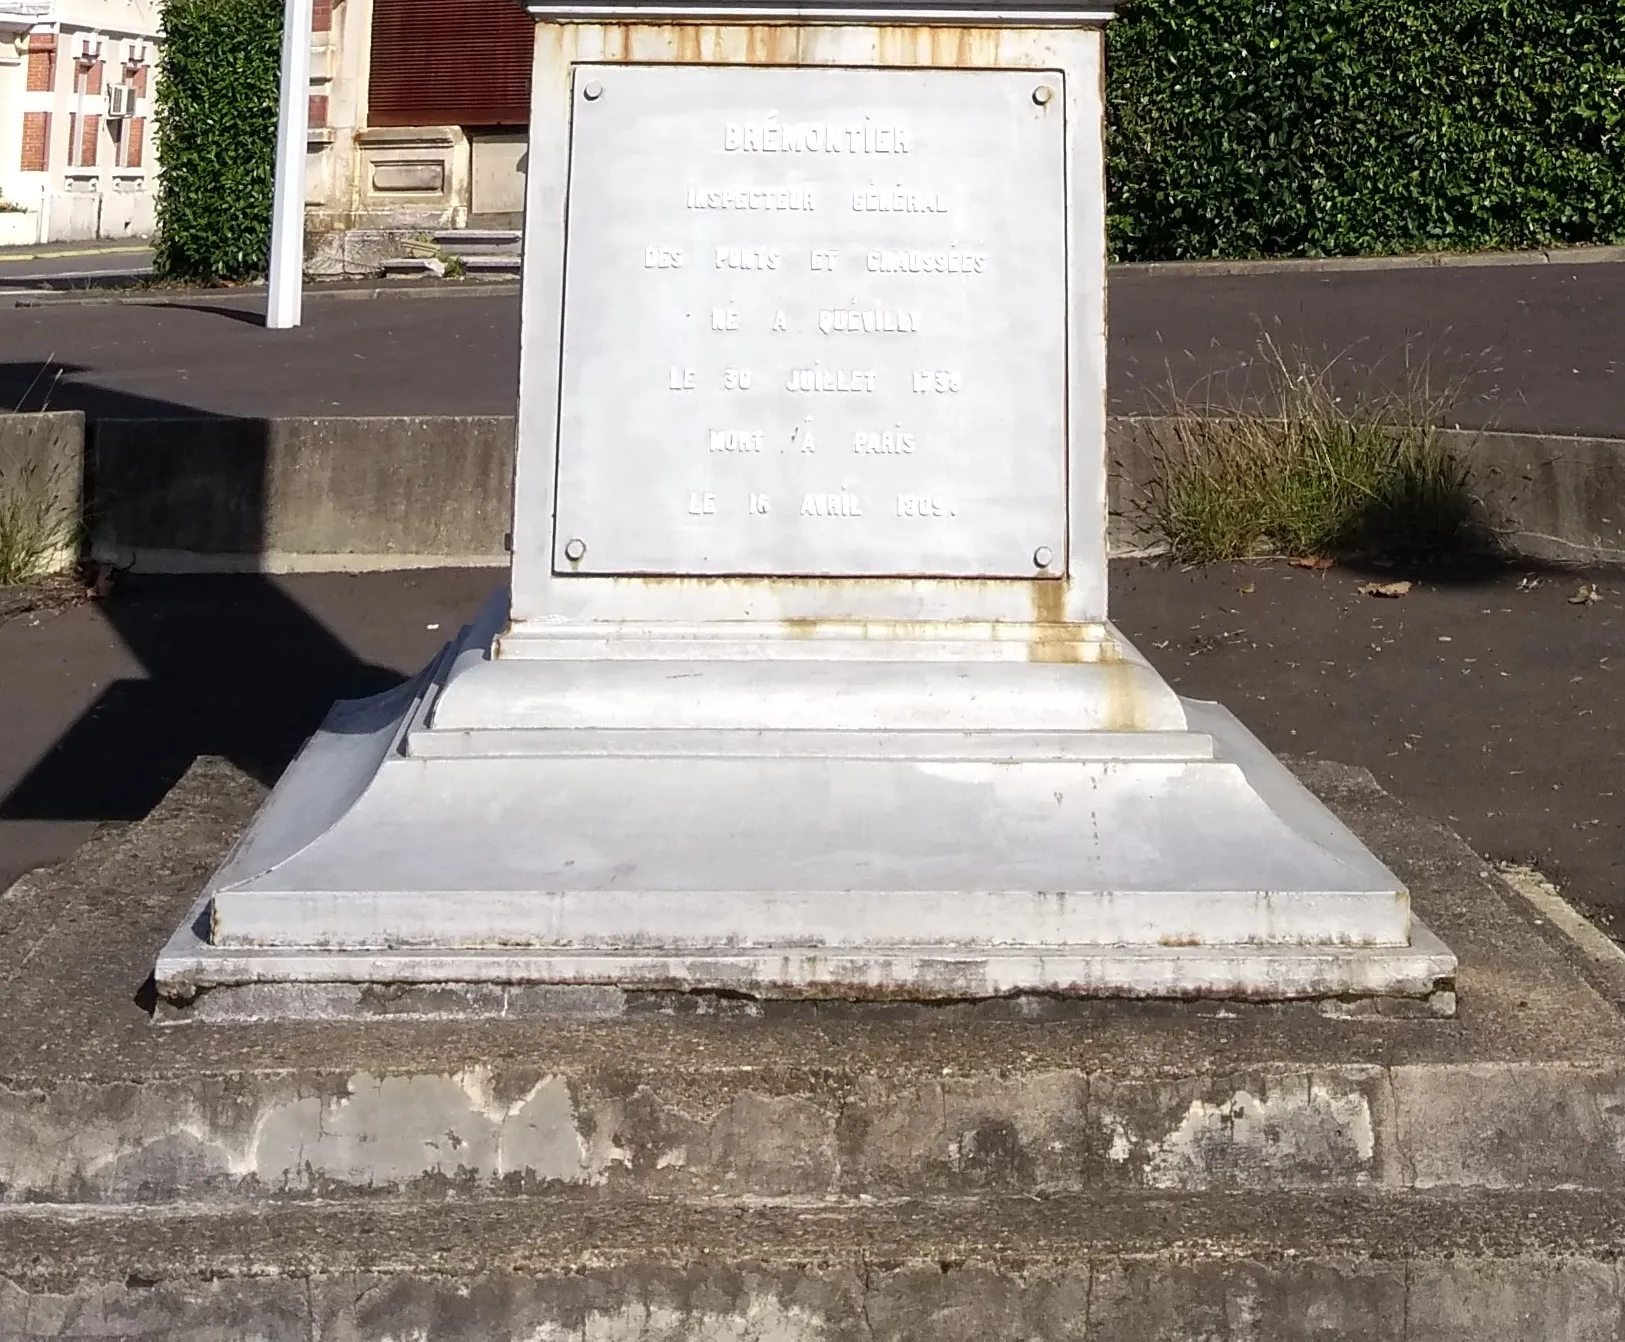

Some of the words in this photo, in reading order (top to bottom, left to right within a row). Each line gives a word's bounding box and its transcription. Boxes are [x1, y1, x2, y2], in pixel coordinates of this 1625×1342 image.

[724, 111, 911, 154] BRÉMONTIER
[686, 182, 816, 212] INSPECTEUR
[851, 181, 949, 213] GÉNÉRAL
[643, 246, 684, 272] DES
[714, 246, 781, 272] PONTS
[808, 247, 838, 272] ET
[866, 241, 989, 274] CHAUSSÉES
[711, 298, 741, 332] NÉ
[669, 368, 697, 392] LE
[724, 369, 751, 392] 30
[785, 362, 877, 393] JUILLET
[708, 428, 765, 453] MORT
[853, 422, 918, 455] PARIS
[688, 491, 717, 516] LE
[800, 488, 864, 518] AVRIL
